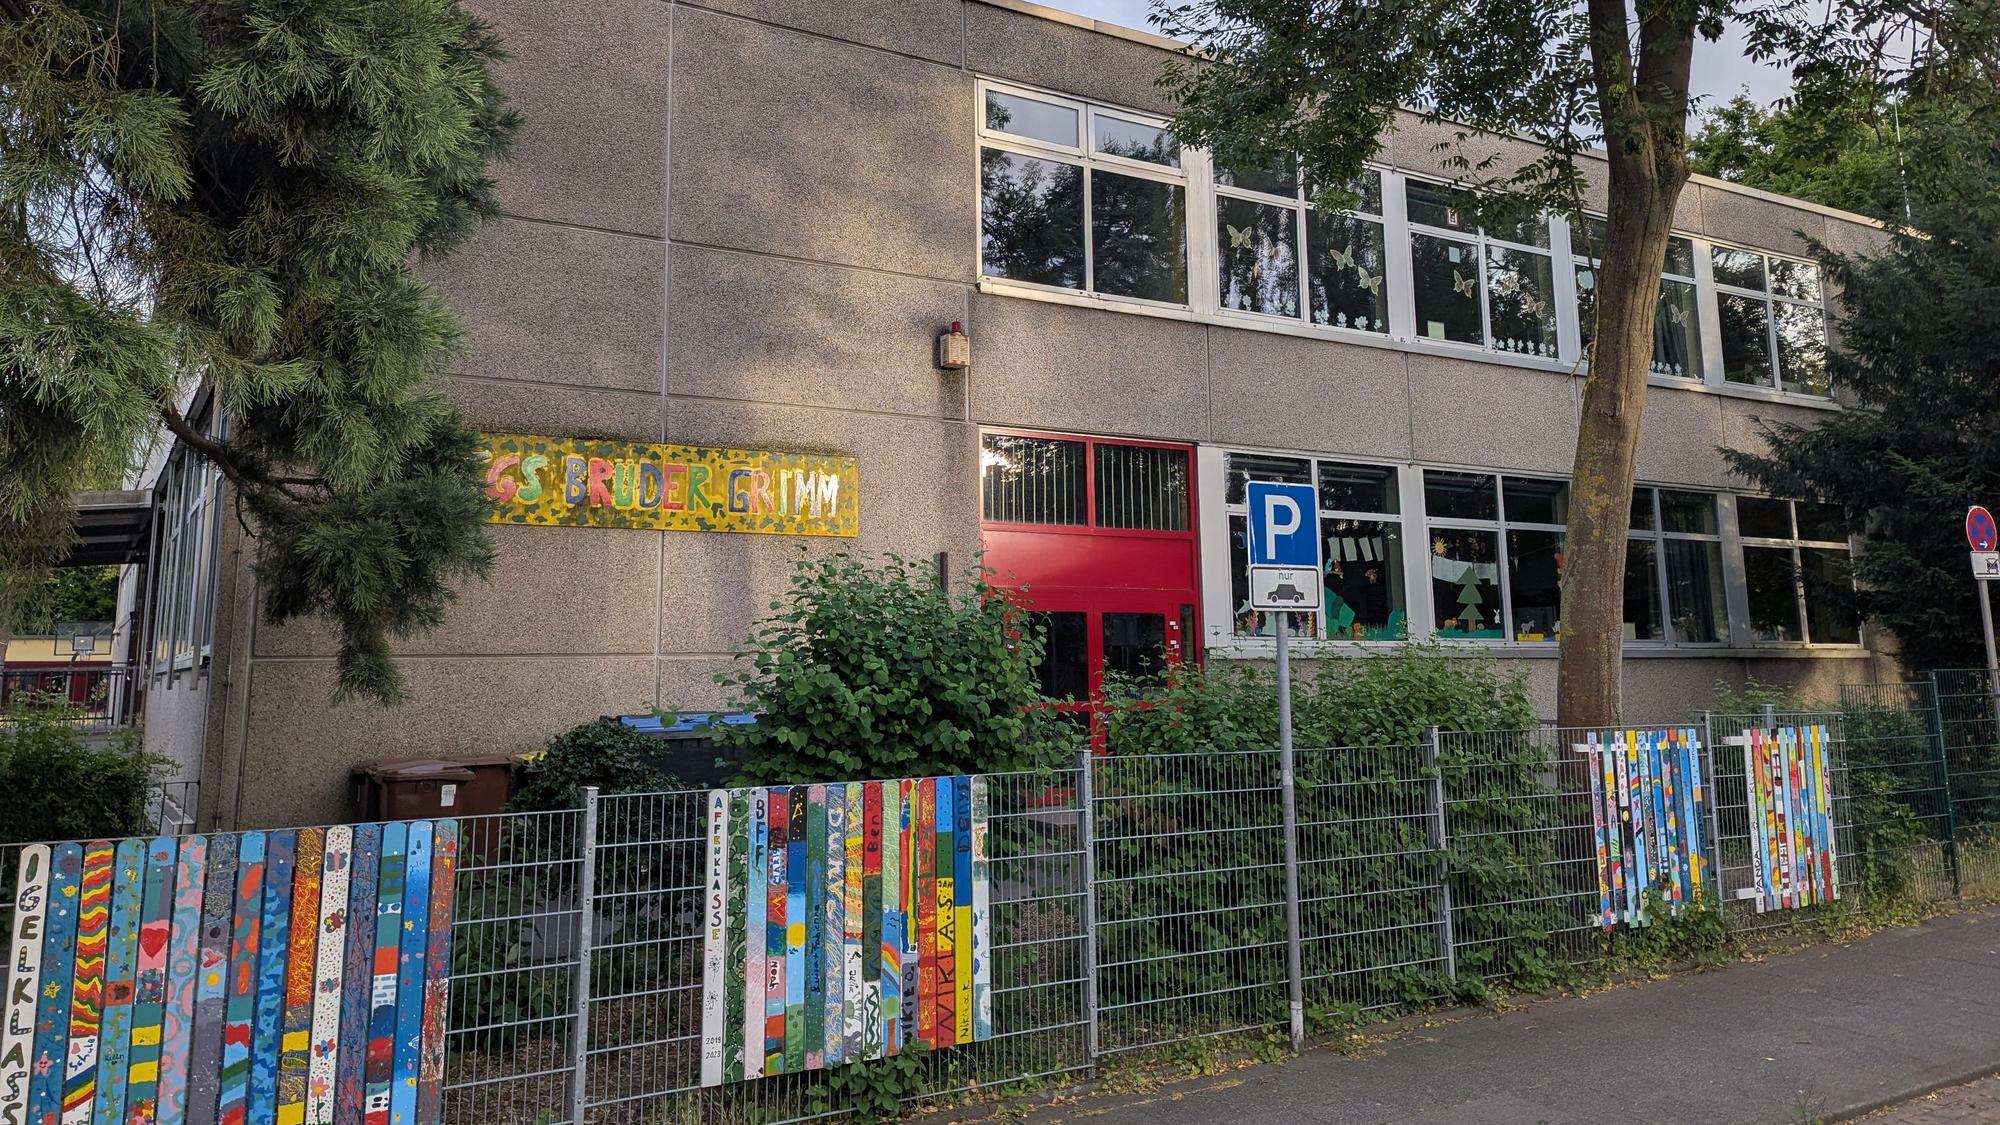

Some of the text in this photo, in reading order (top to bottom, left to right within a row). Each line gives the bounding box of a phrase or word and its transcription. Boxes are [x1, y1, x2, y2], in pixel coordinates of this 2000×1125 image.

[727, 468, 840, 519] GRIMM
[1265, 494, 1302, 560] P
[1278, 571, 1295, 581] nur
[867, 814, 879, 853] Ben
[710, 796, 723, 942] AFFENKLASSE
[1753, 850, 1764, 894] PANDA
[69, 1038, 96, 1072] Schule
